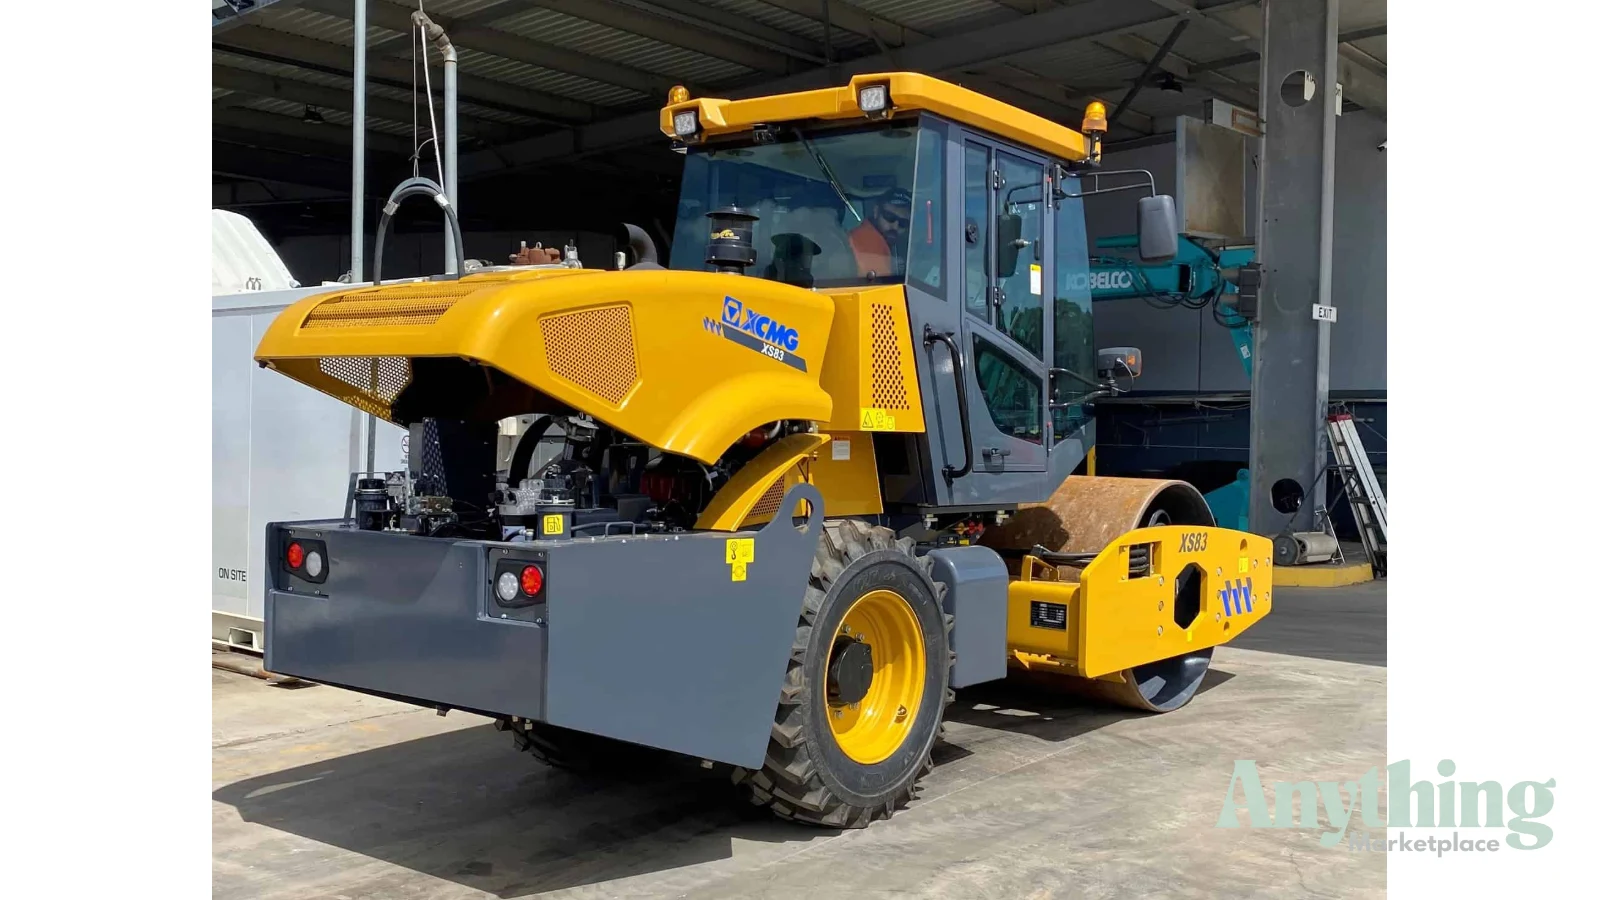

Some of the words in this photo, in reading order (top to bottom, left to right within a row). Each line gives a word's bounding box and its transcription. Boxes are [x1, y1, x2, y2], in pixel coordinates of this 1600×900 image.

[1065, 271, 1133, 290] KOBELCO
[1318, 307, 1332, 319] EXIT
[741, 309, 799, 351] XCMG
[761, 343, 785, 361] XS83
[1178, 532, 1208, 553] XS83
[218, 567, 230, 579] ON
[231, 569, 247, 582] SITE
